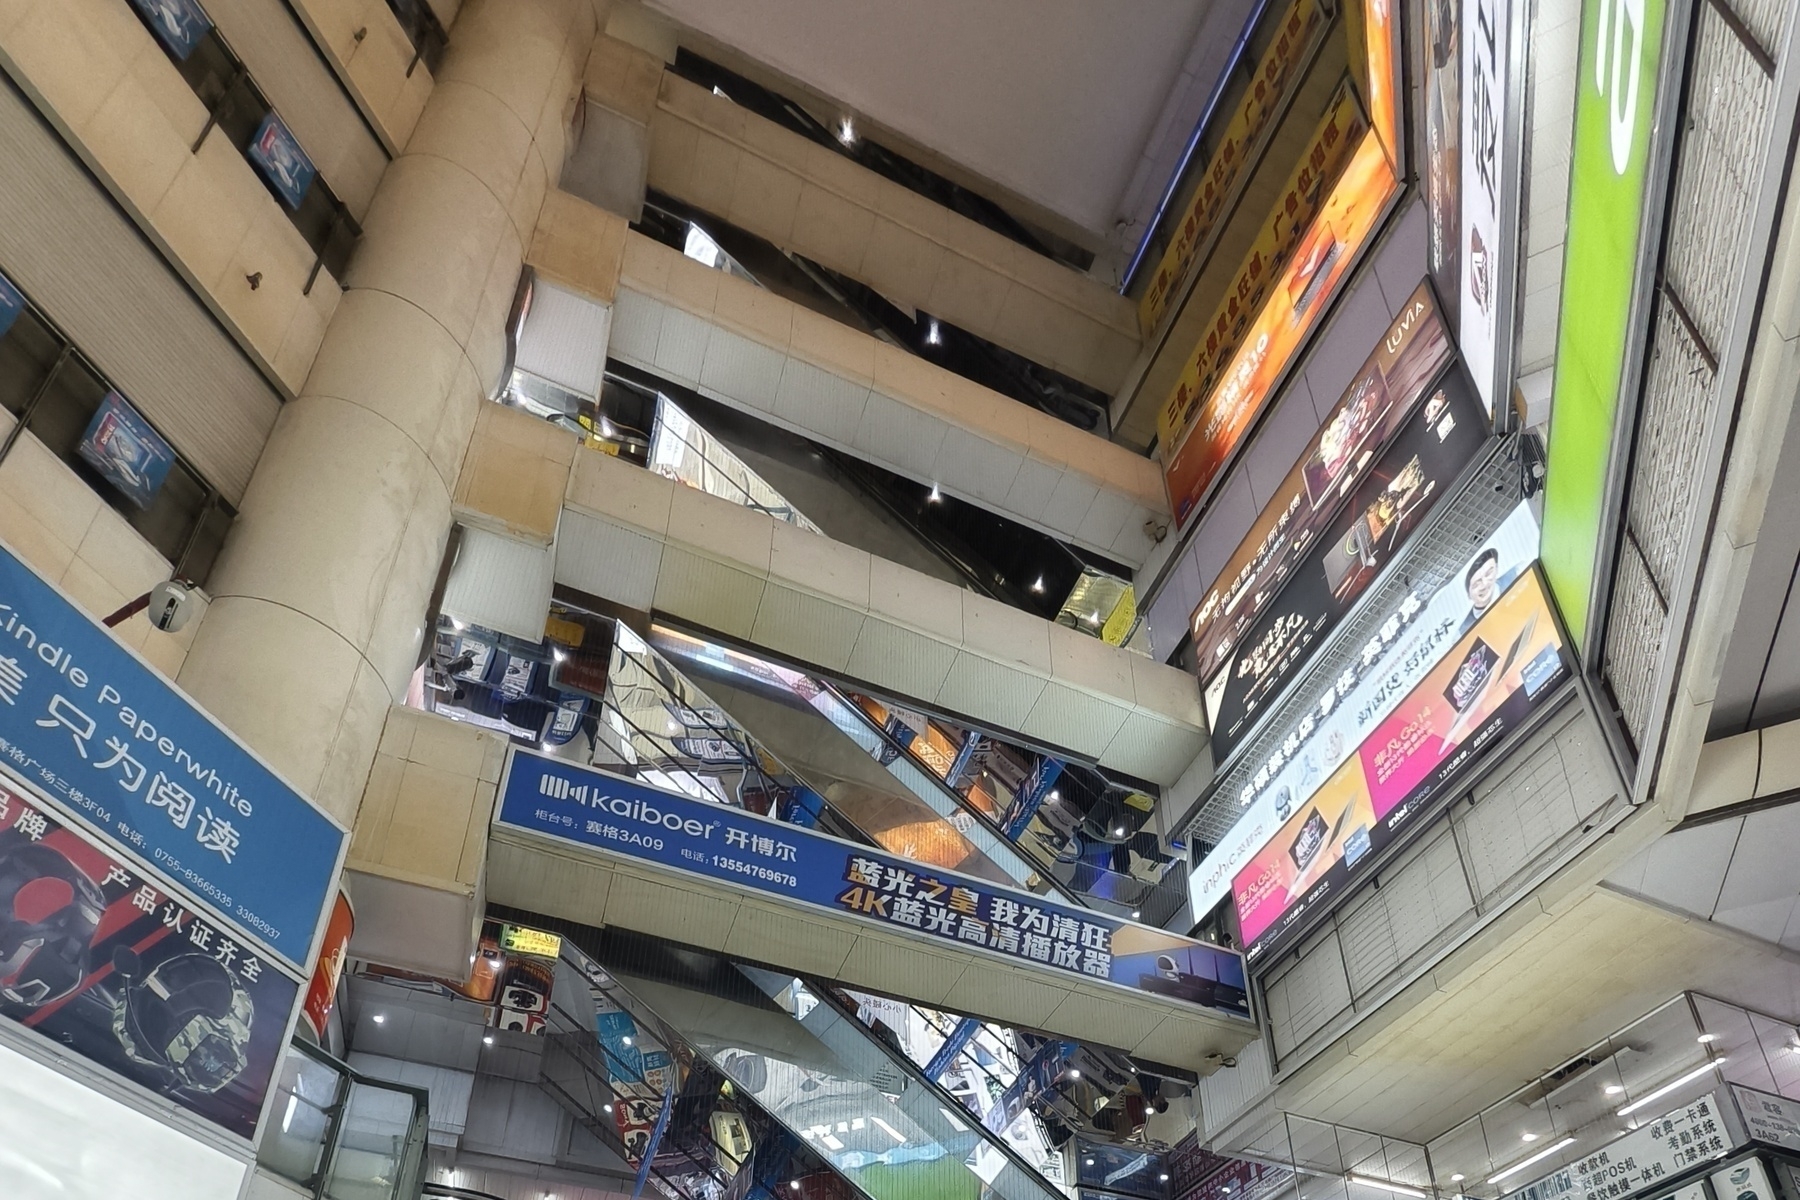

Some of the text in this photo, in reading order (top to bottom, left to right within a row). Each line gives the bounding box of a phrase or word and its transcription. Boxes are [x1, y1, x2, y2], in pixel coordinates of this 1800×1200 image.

[1194, 589, 1219, 633] AOC
[36, 693, 241, 864] 只为阅读
[97, 684, 253, 818] Paperwhite
[585, 819, 664, 852] 赛格3A09
[712, 854, 798, 888] 13554769678
[592, 788, 798, 863] kaiboer 开博尔
[101, 864, 263, 983] 产品认证齐全
[839, 886, 1112, 979] 4K蓝光高清播放器
[849, 857, 1111, 952] 蓝光之皇 我为清狂
[1650, 1101, 1711, 1141] 收费一卡通
[1667, 1119, 1718, 1151] 考勤系统
[1673, 1135, 1724, 1168] 门禁系统
[1577, 1151, 1610, 1176] 收款机
